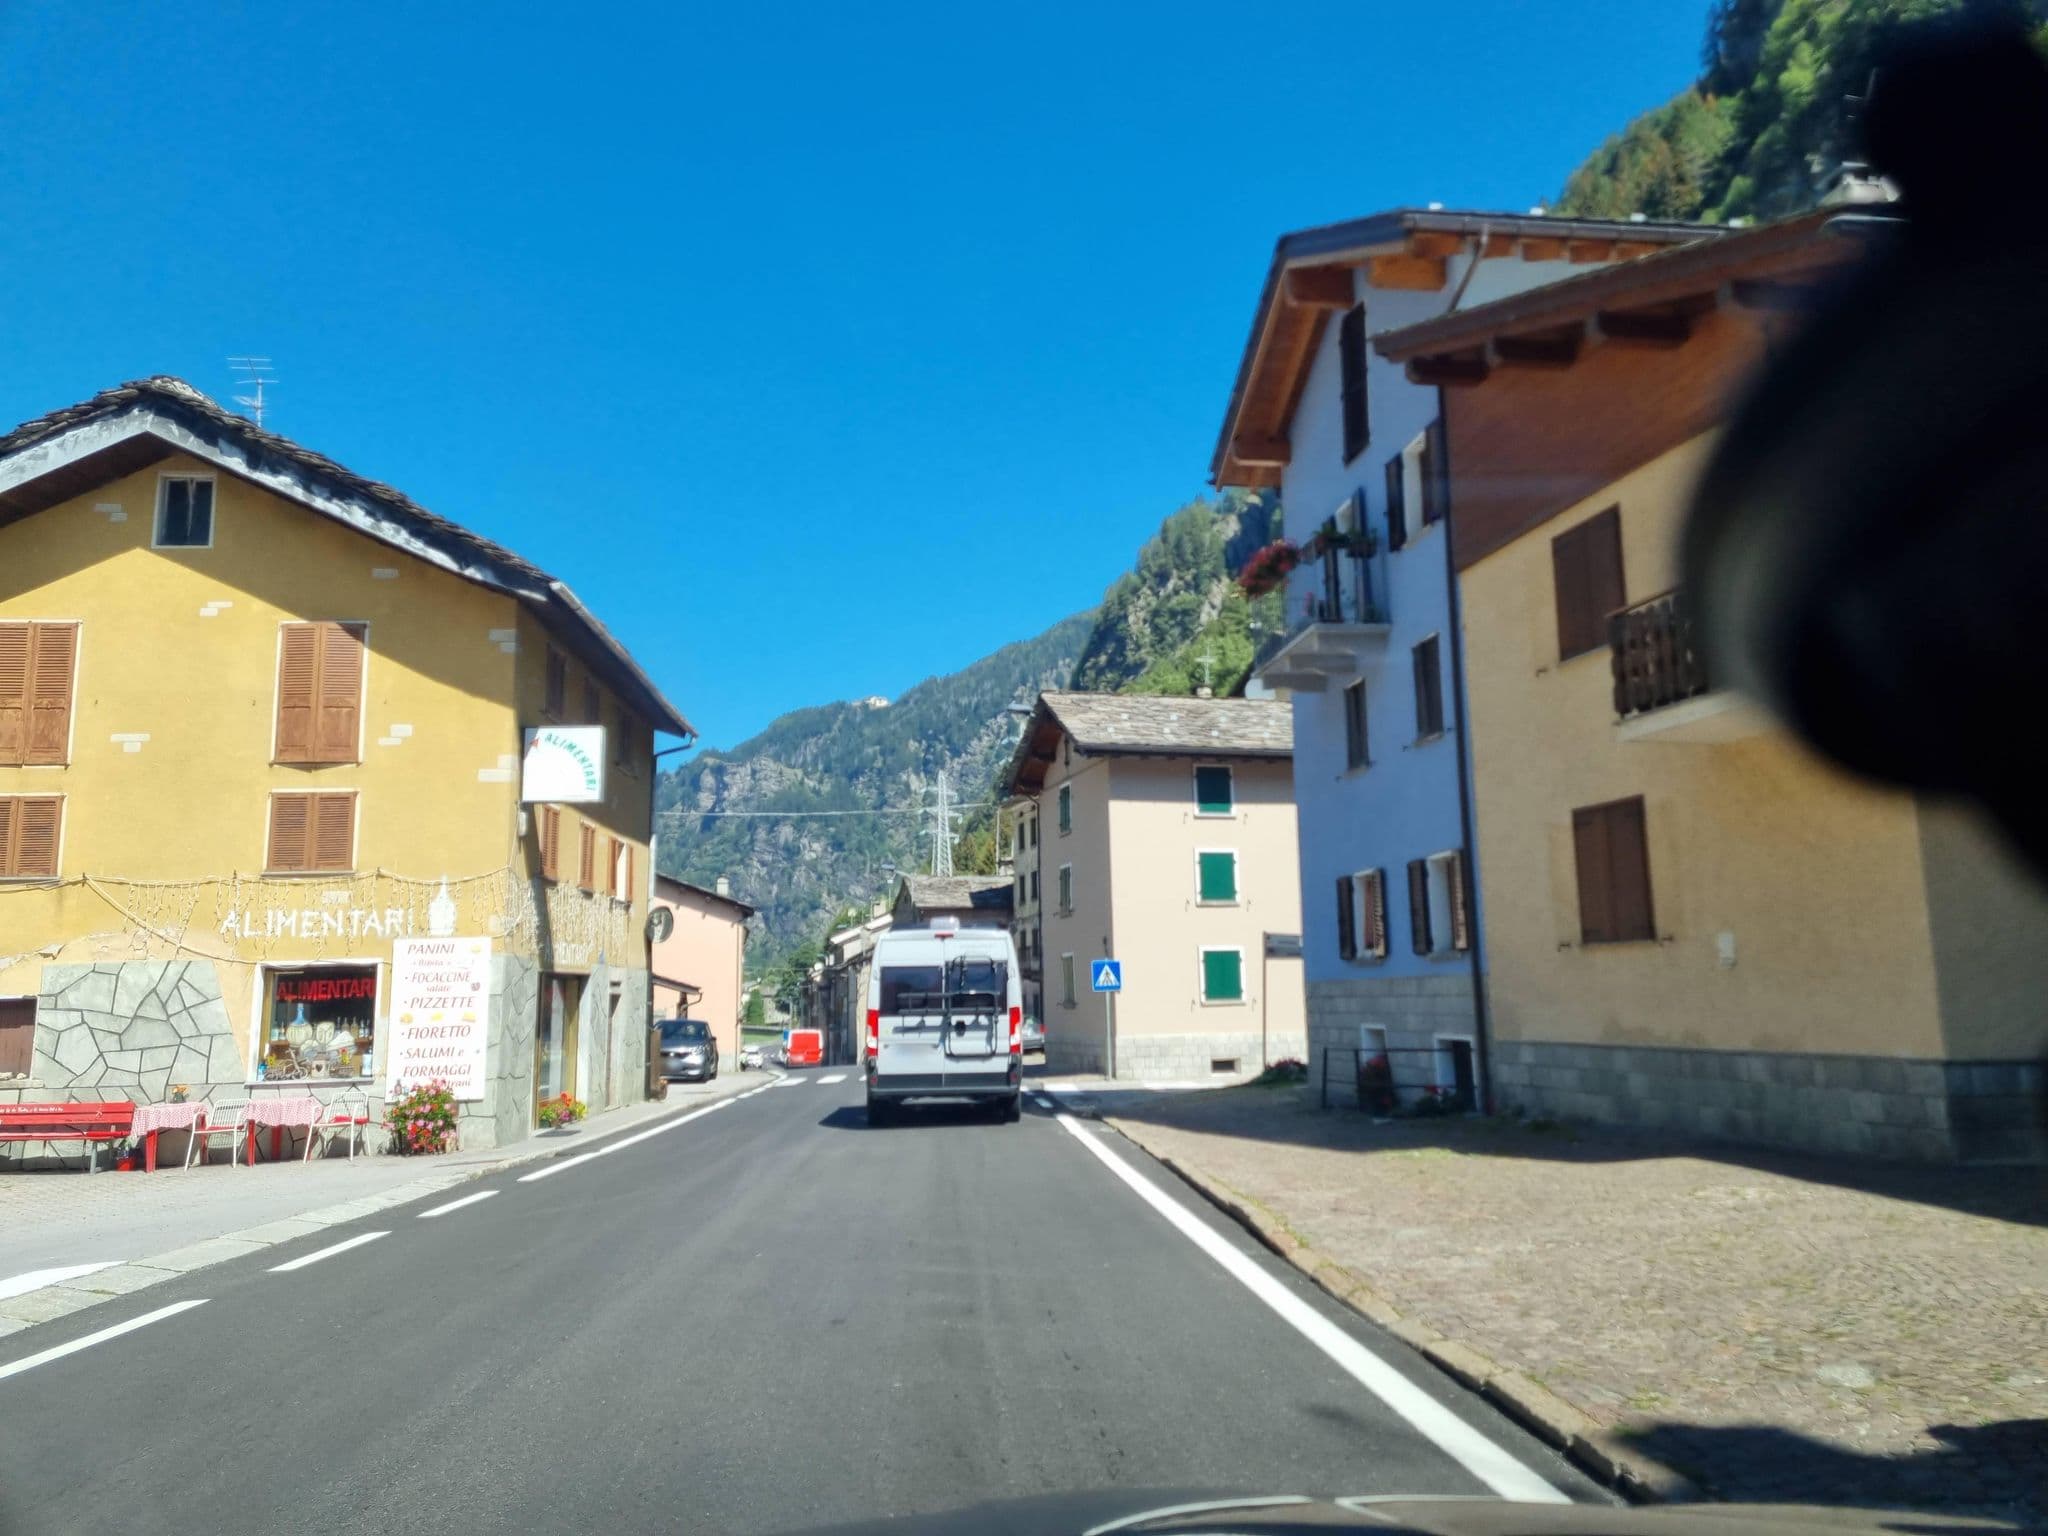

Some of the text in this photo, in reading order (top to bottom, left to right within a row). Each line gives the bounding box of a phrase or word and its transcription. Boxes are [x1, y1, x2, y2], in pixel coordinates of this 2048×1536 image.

[544, 733, 596, 791] ALIMENTARI
[219, 908, 414, 937] ALIMENTARI
[408, 943, 455, 955] PANINI
[411, 972, 471, 984] FOCACCINE
[410, 996, 474, 1008] PIZZETTE
[407, 1024, 471, 1040] FIORETTO
[404, 1046, 455, 1059] SALUMI
[403, 1064, 471, 1077] FORMAGGI
